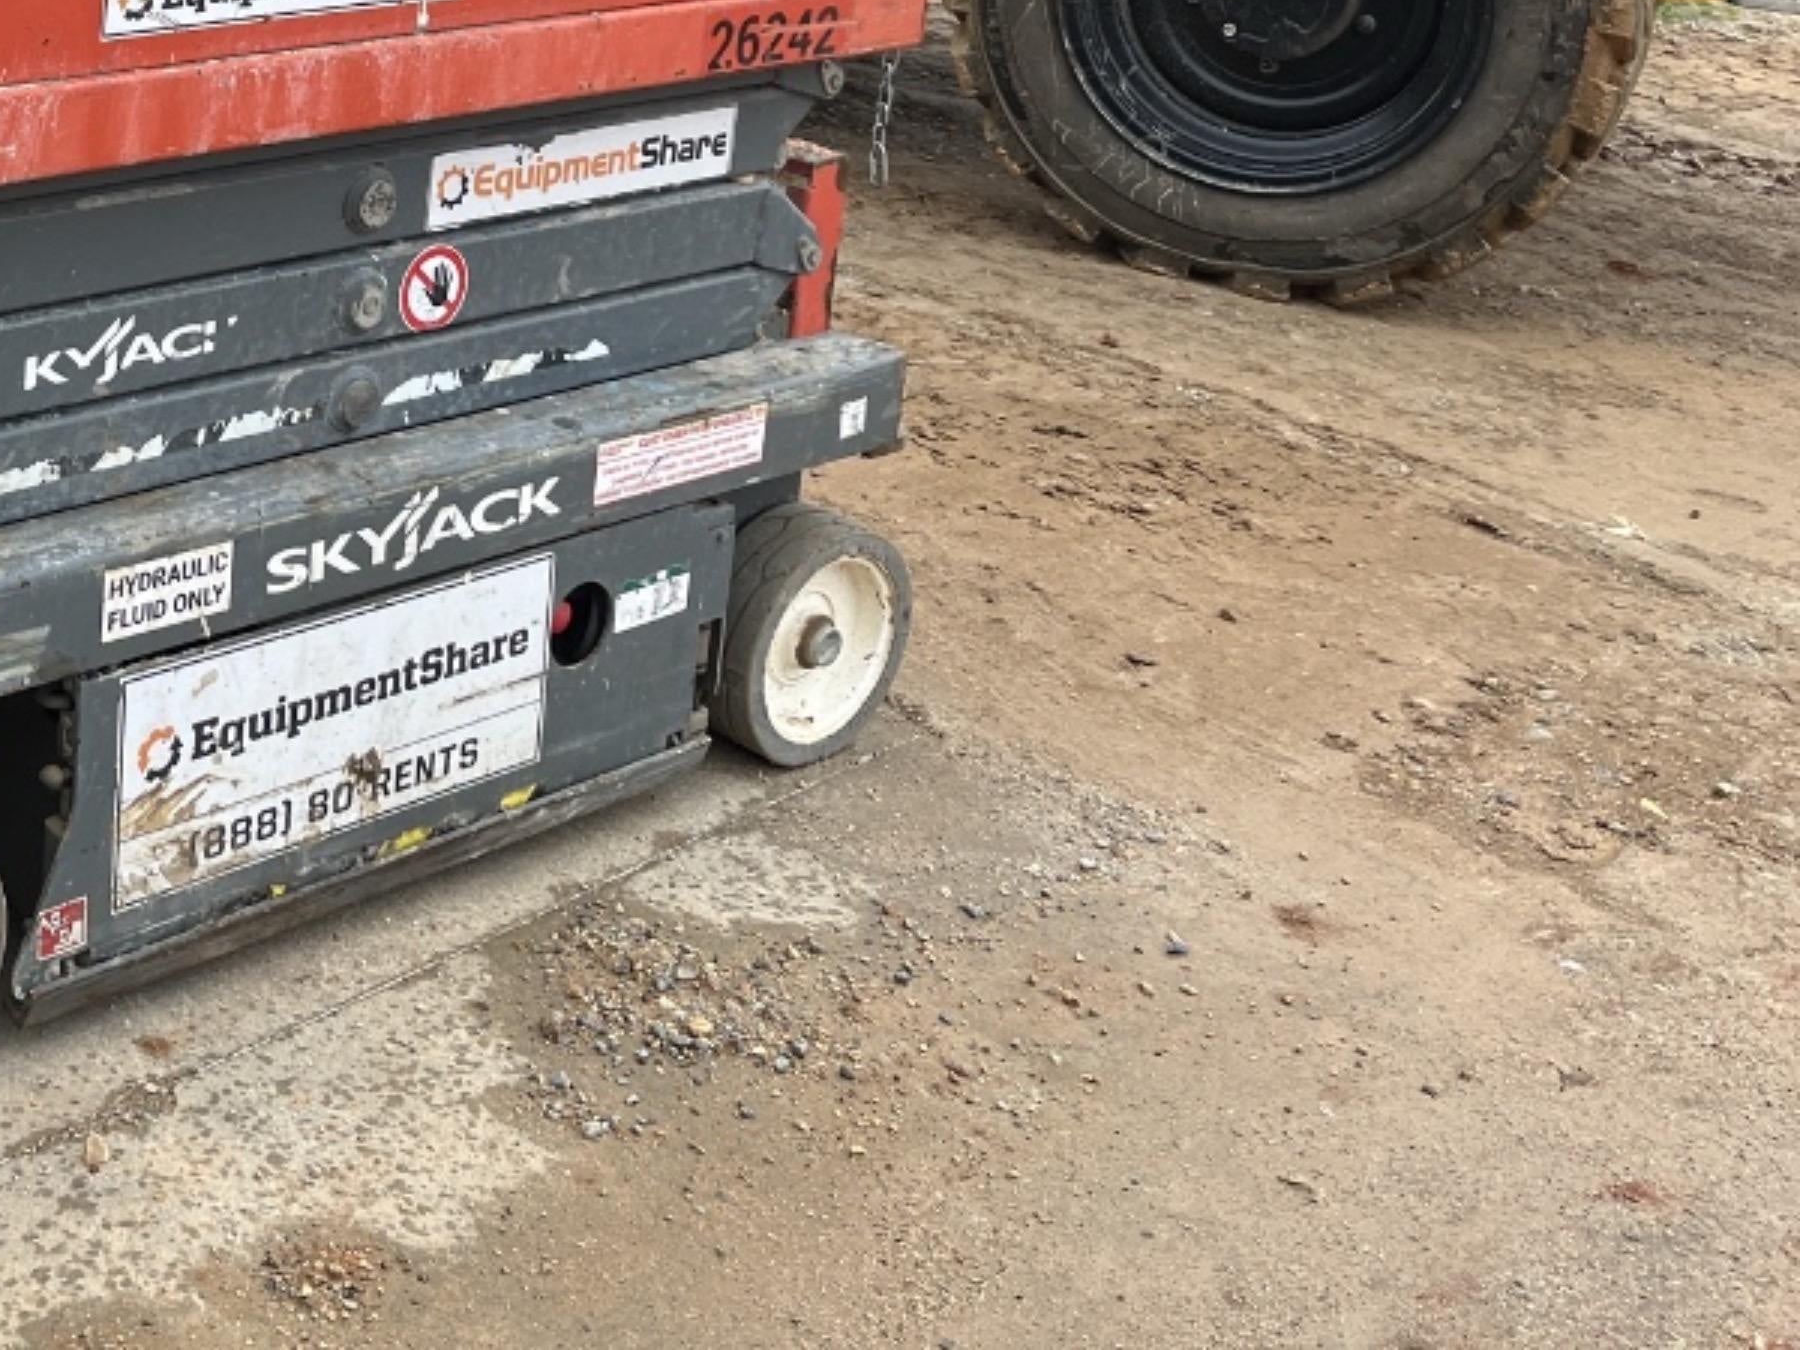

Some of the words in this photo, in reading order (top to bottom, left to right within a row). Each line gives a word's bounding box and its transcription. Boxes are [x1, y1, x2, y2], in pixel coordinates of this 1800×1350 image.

[707, 5, 839, 70] 26242
[472, 131, 728, 199] EquipmentShare
[266, 476, 561, 595] SKYJACK
[106, 598, 168, 634] FLUID
[173, 581, 226, 614] ONLY
[107, 550, 229, 602] HYDRAULIC
[190, 628, 529, 761] EquipmentShare
[187, 799, 293, 868] (888)
